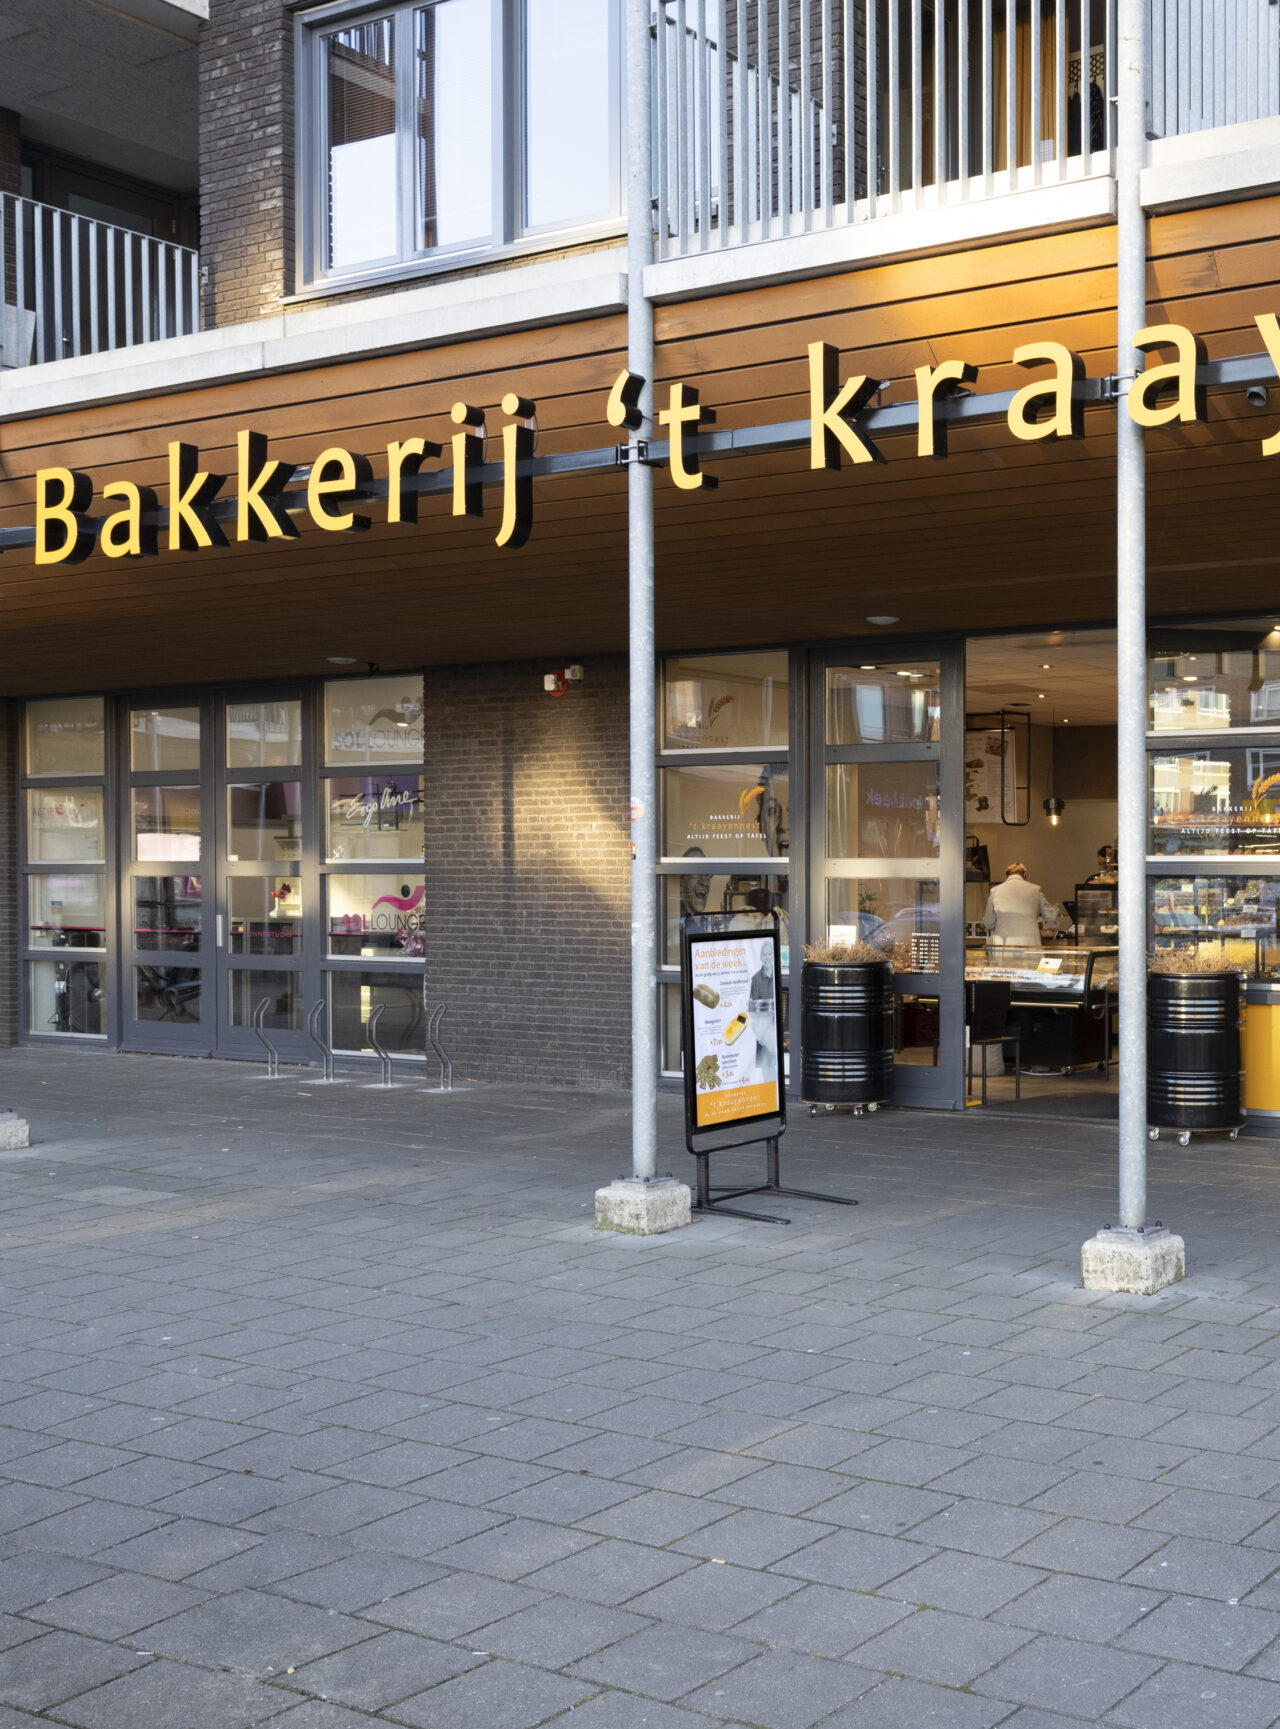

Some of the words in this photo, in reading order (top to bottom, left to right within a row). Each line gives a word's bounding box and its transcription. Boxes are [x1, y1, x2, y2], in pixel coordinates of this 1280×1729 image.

[35, 392, 536, 565] Bakkerij
[342, 913, 369, 930] SOL
[695, 947, 746, 959] Aanbiedingen
